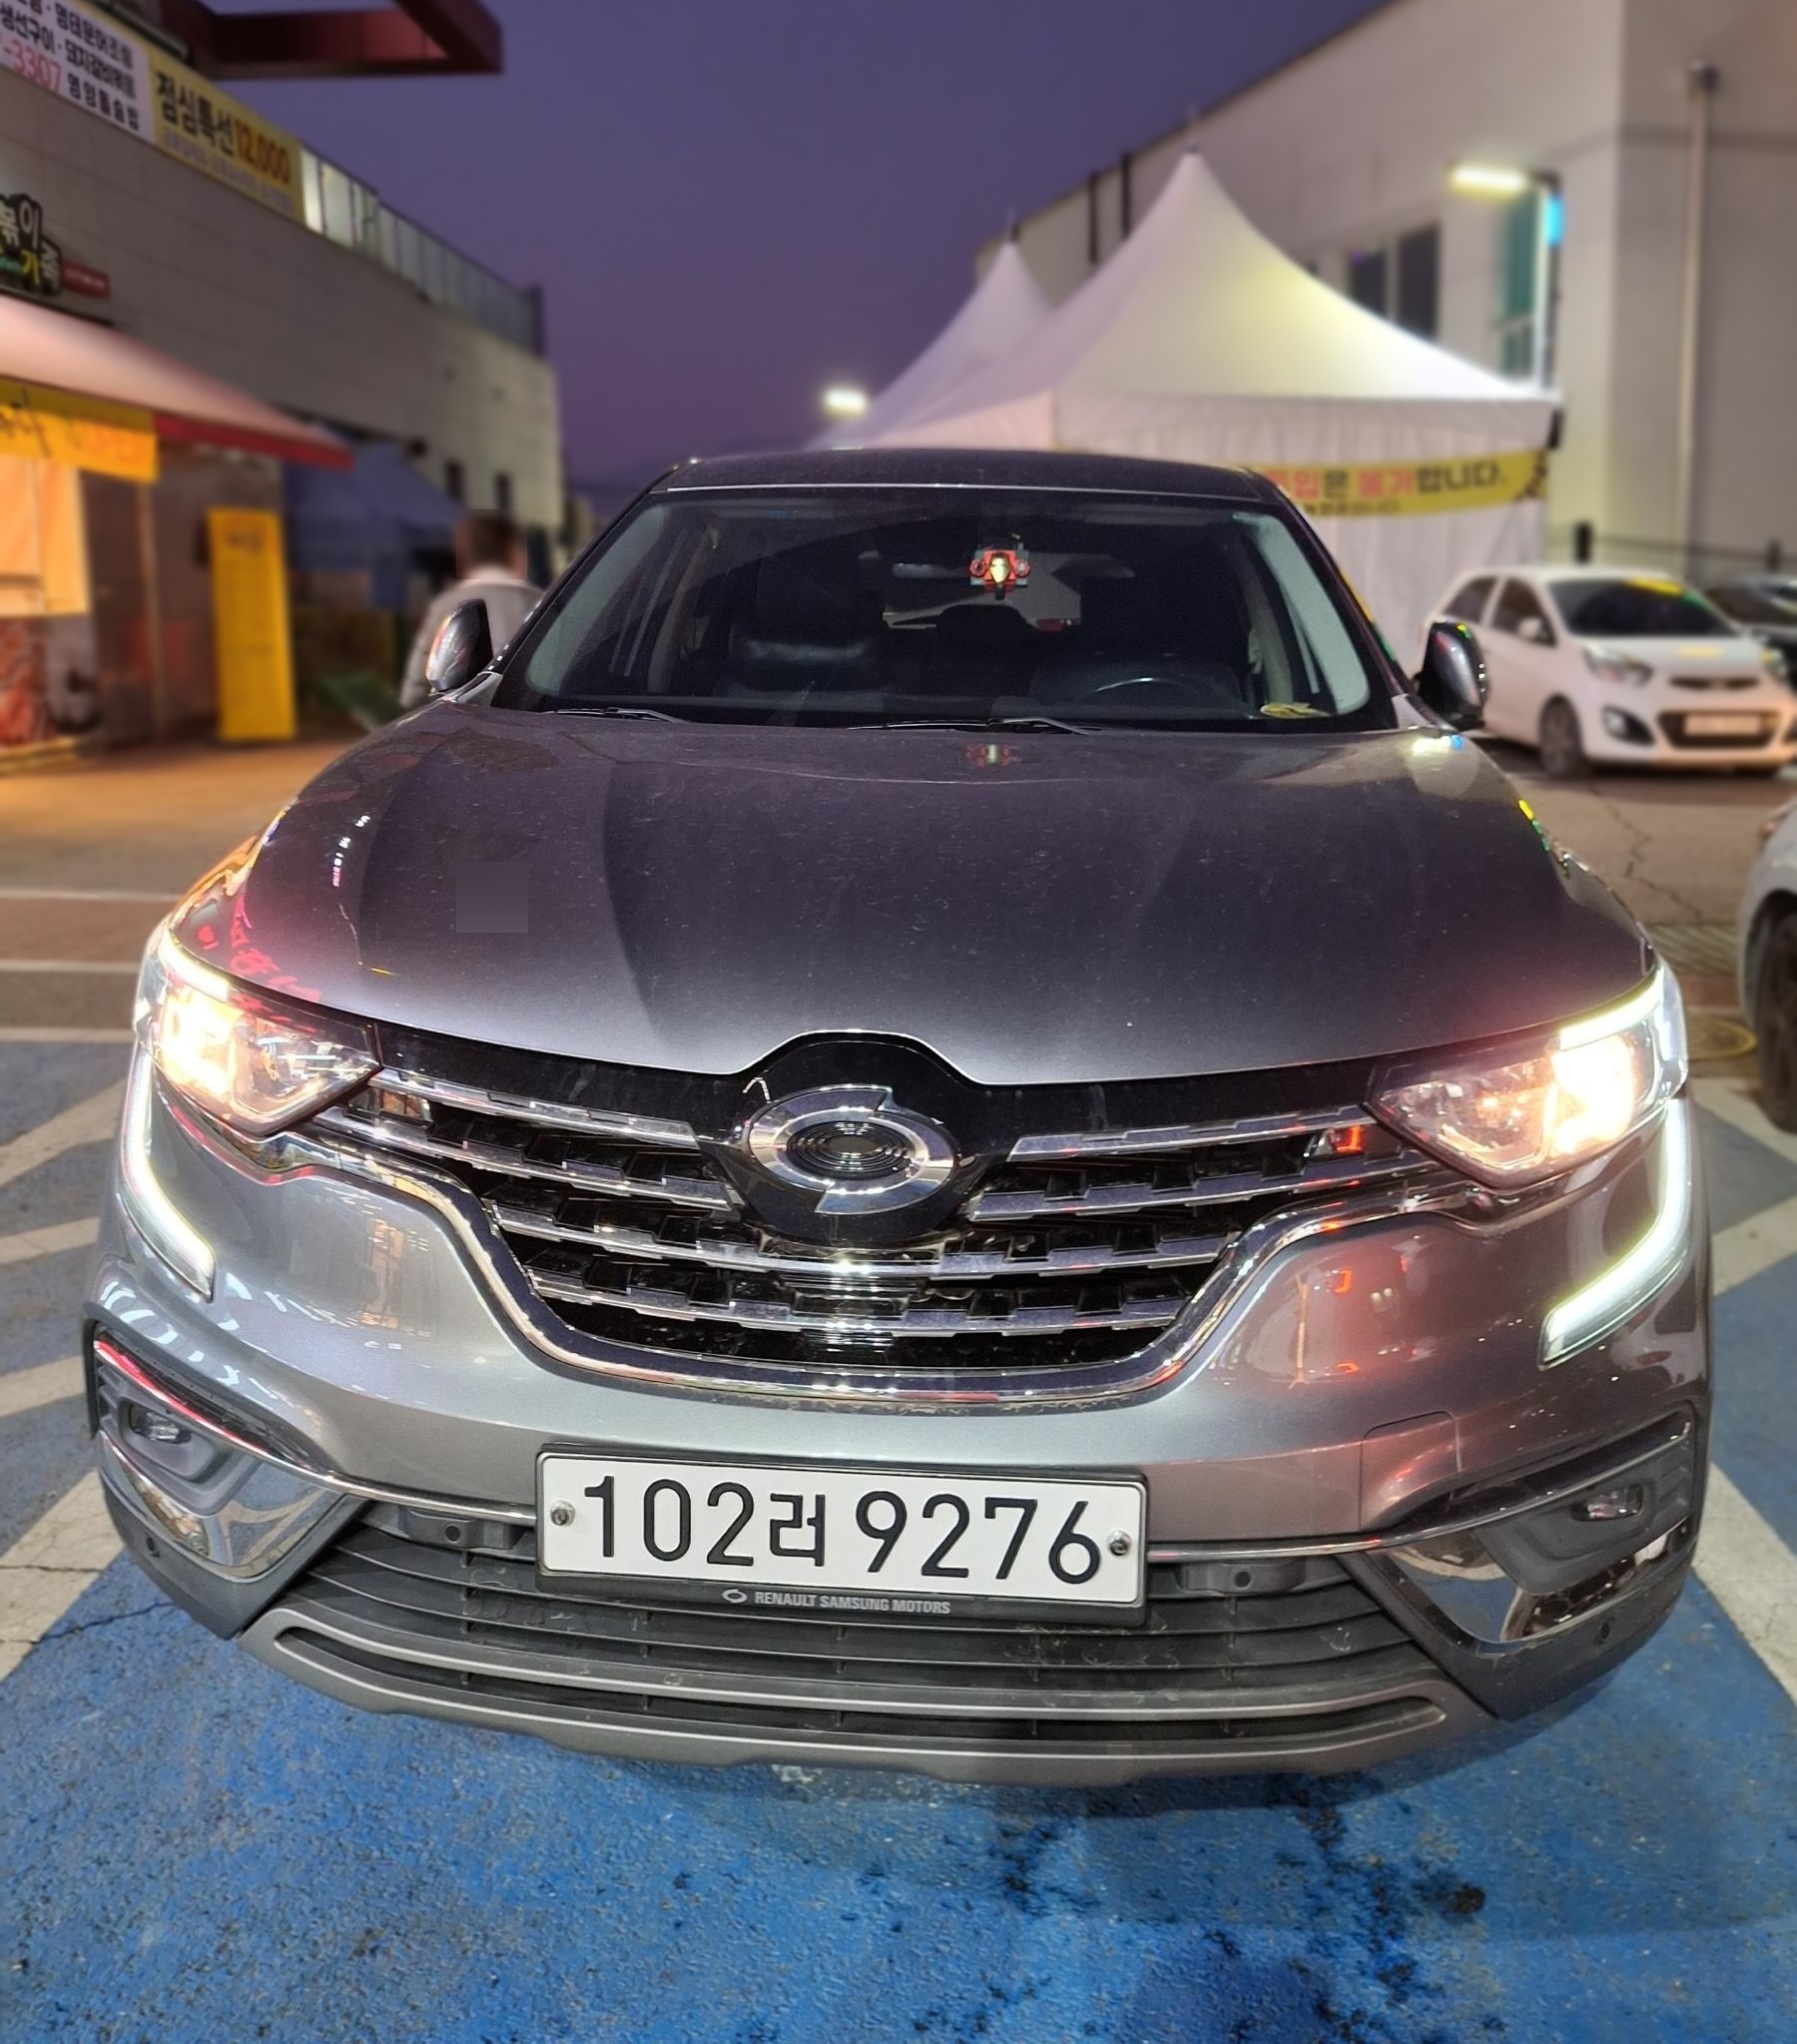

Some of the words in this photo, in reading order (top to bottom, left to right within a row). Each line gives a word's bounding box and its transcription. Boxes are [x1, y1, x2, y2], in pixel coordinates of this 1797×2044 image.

[583, 1475, 827, 1567] 102러
[855, 1490, 1102, 1585] 9276
[755, 1591, 818, 1607] RENAULT
[820, 1596, 891, 1612] SAMSUNG
[892, 1601, 951, 1615] MOTORS
